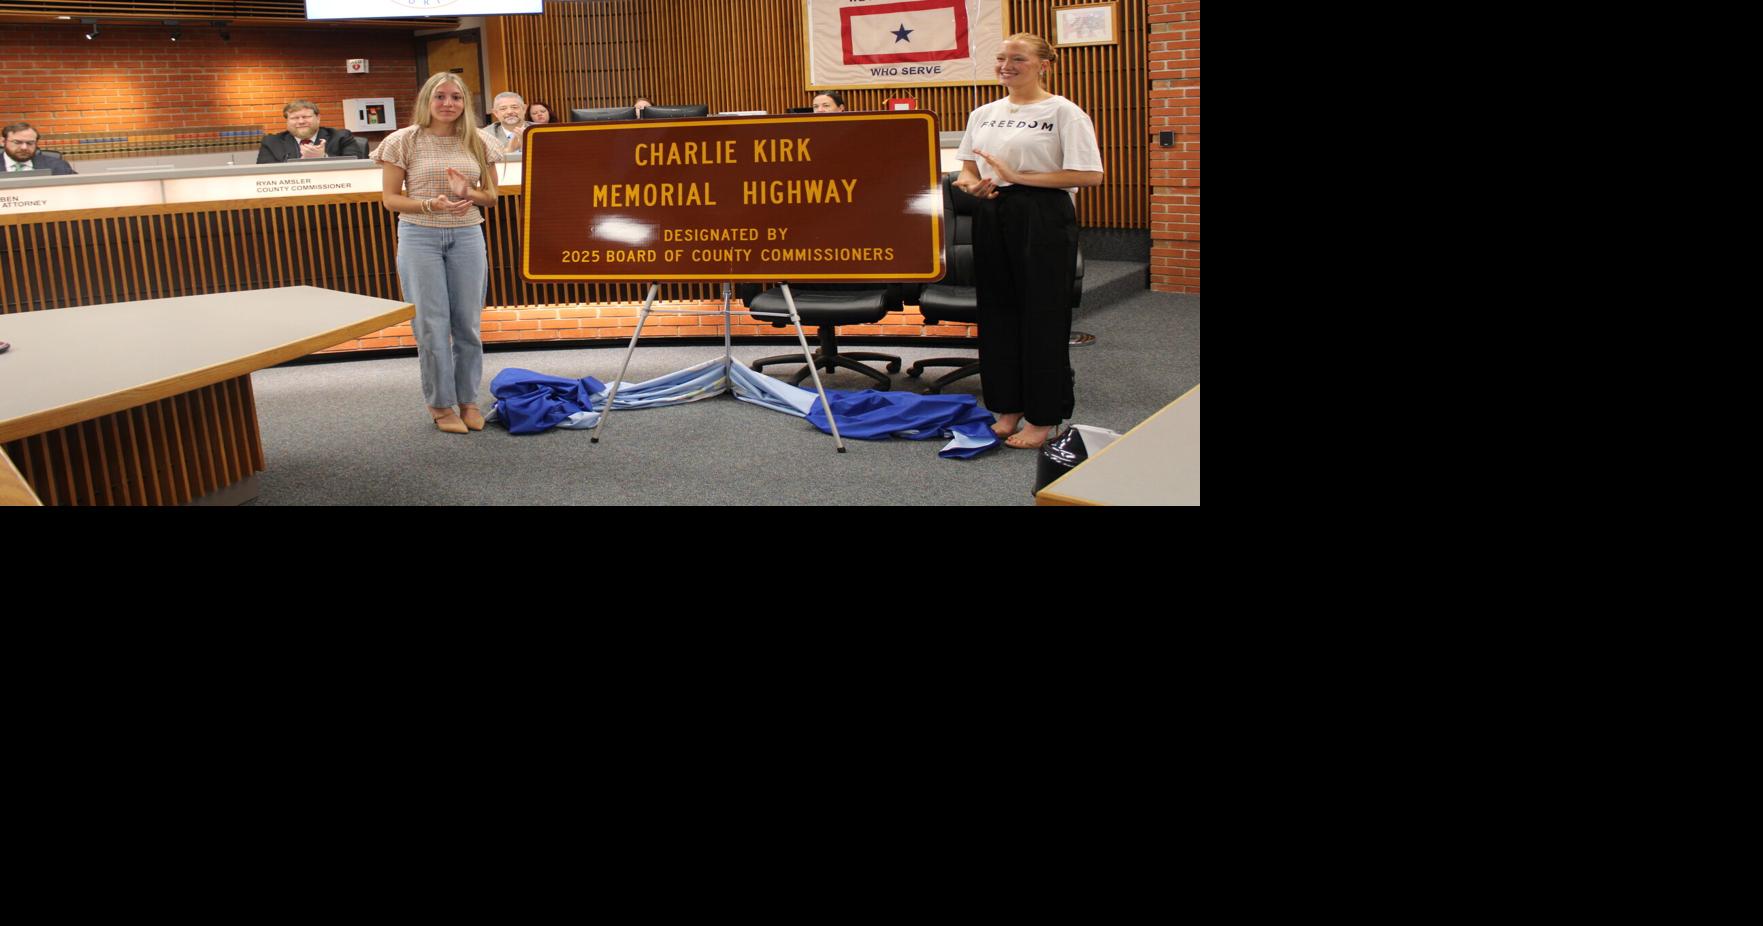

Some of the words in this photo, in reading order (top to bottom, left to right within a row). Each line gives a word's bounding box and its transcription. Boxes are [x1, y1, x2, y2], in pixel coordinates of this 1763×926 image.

[871, 67, 898, 76] WHO
[901, 66, 942, 75] SERVE
[980, 120, 1053, 131] FREEDOM
[635, 140, 737, 166] CHARLIE
[754, 138, 812, 163] KIRK
[291, 183, 352, 191] COMMISSIONER
[593, 182, 717, 208] MEMORIAL
[743, 179, 857, 205] HIGHWAY
[2, 200, 47, 208] ATTORNEY
[664, 228, 758, 242] DESIGNATED
[767, 228, 788, 241] BY
[561, 250, 600, 264] 2025
[606, 249, 656, 263] BOARD
[664, 248, 682, 262] OF
[692, 248, 751, 262] COUNTY
[760, 247, 894, 262] COMMISSIONERS
